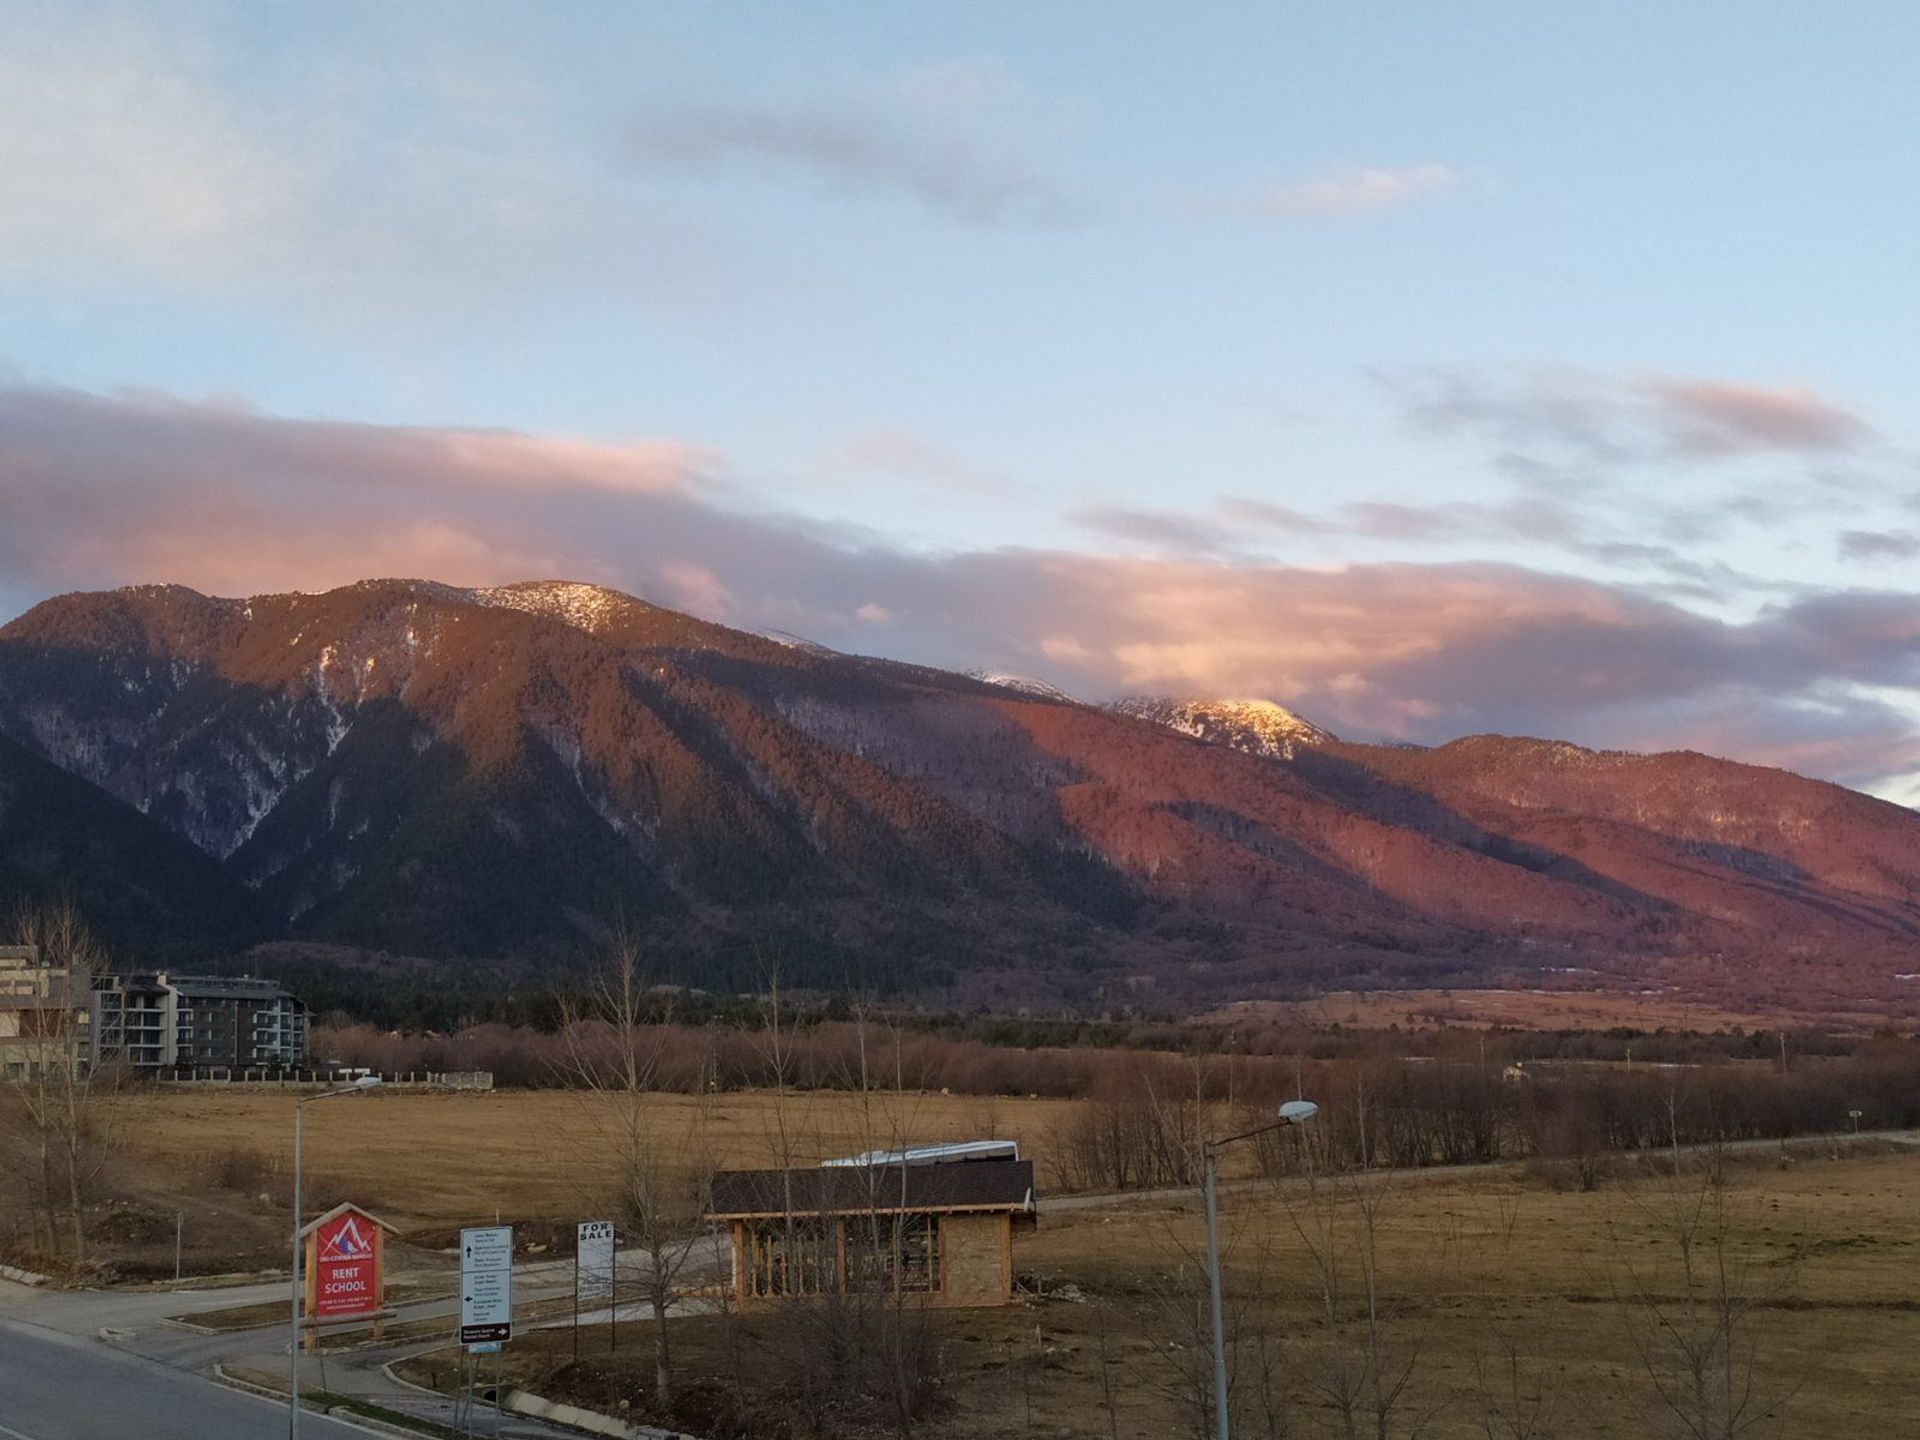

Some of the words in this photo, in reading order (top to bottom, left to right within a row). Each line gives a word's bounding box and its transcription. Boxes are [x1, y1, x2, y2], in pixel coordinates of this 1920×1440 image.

[583, 1223, 609, 1233] FOR
[580, 1230, 612, 1241] SALE
[332, 1267, 359, 1280] RENT
[325, 1280, 366, 1294] SCHOOL
